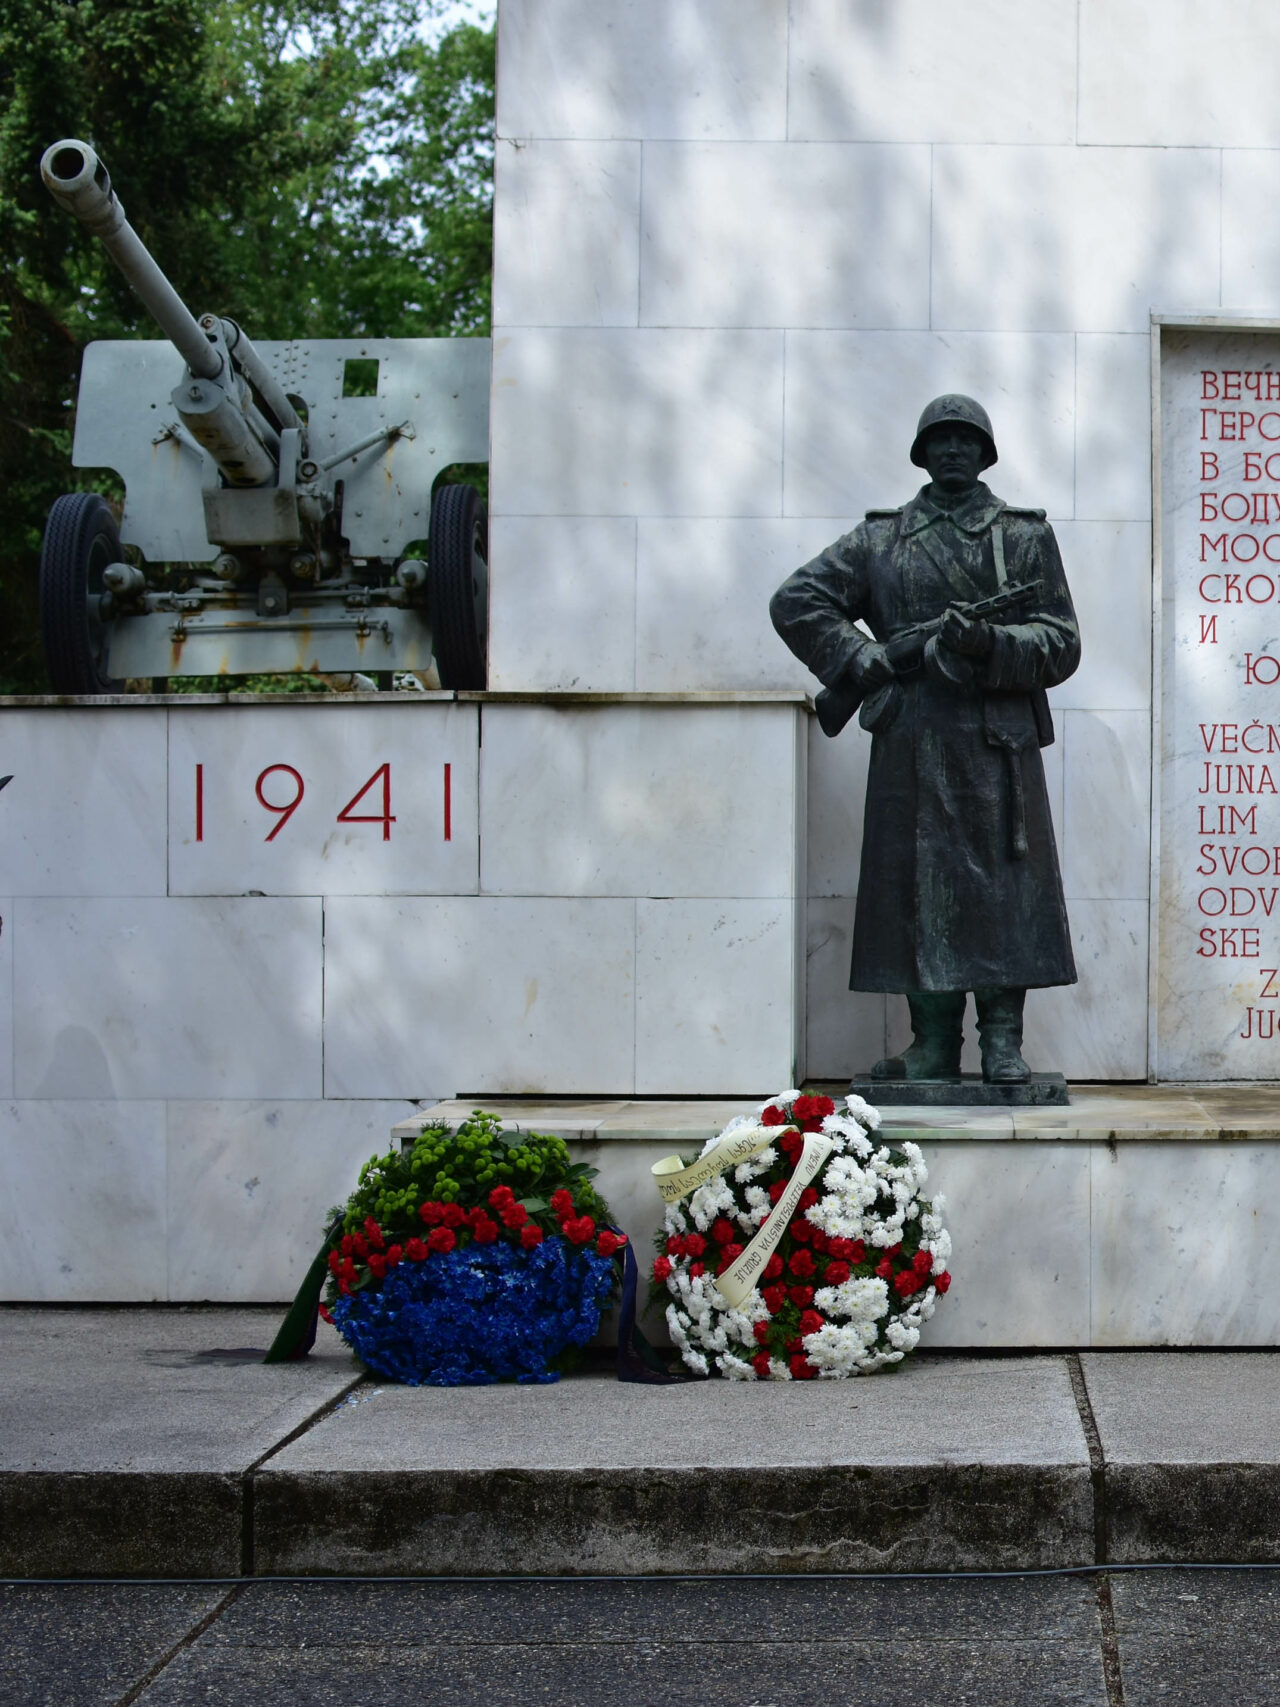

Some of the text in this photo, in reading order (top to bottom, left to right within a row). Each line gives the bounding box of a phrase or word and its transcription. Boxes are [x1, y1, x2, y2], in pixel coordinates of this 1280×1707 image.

[1201, 452, 1219, 481] В
[1200, 616, 1217, 644] И
[196, 763, 452, 842] 1941
[1200, 806, 1256, 835] LIM
[1197, 928, 1260, 958] SKE
[805, 1150, 823, 1176] IMENU
[758, 1181, 807, 1251] VELEPOSLANIŠTVA
[734, 1251, 762, 1284] GRUZIJE
